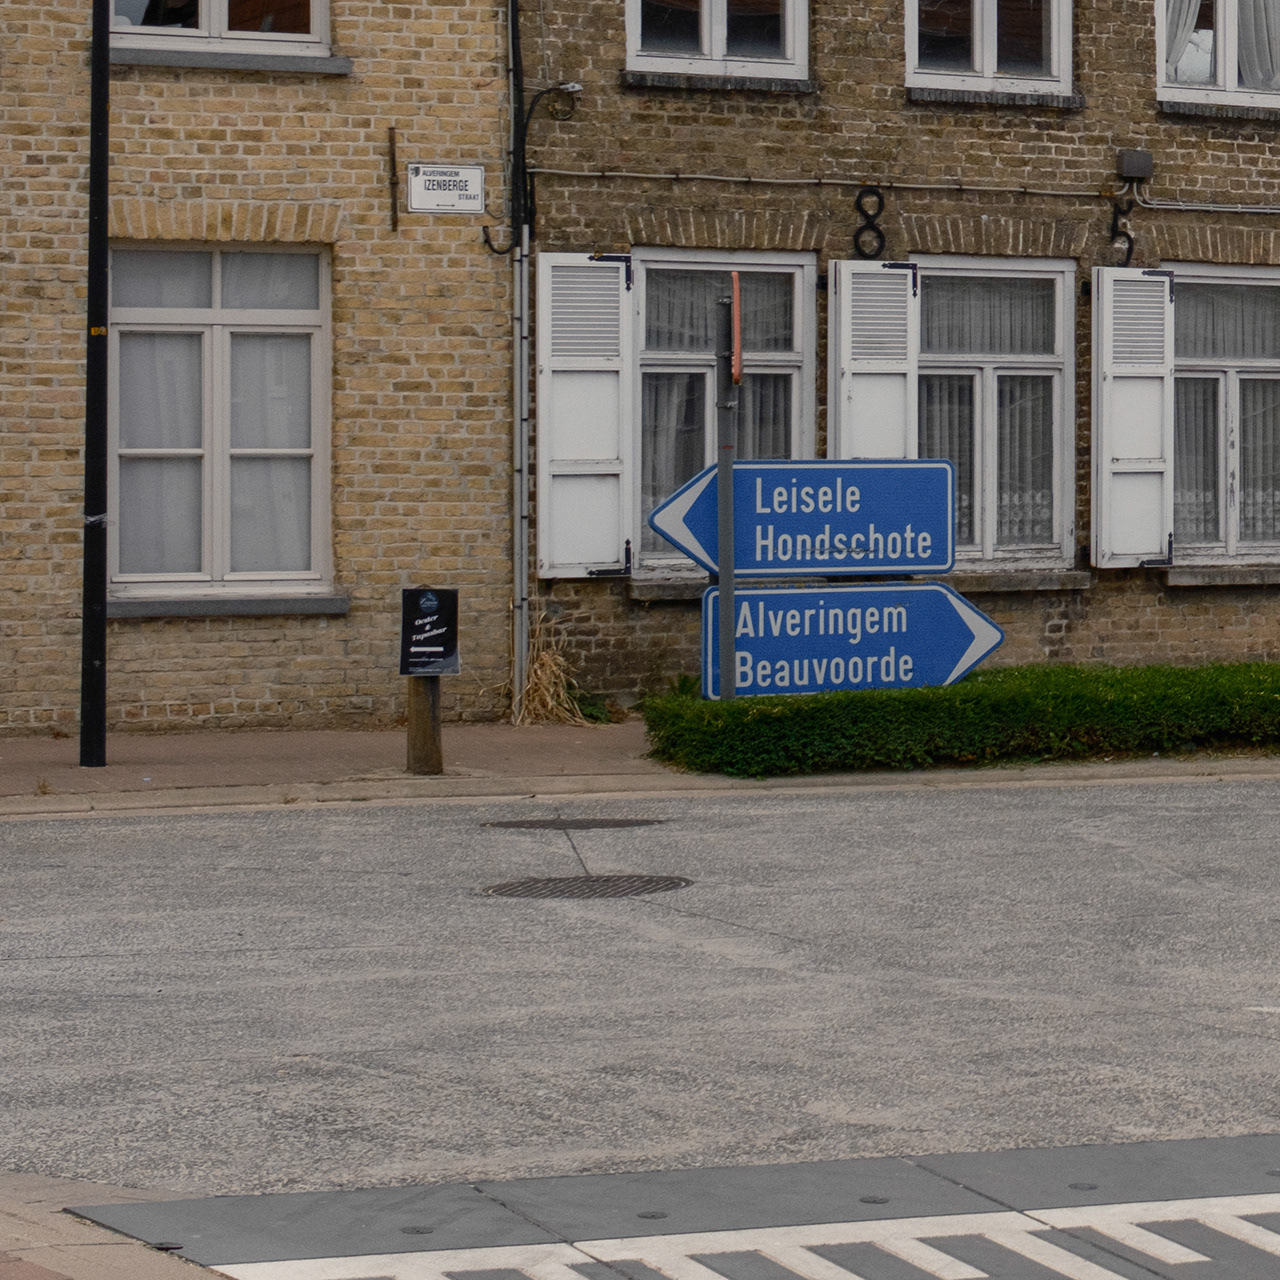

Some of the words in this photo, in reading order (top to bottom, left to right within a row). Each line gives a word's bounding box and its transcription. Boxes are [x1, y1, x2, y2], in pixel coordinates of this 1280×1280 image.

[422, 170, 460, 178] ALVERINGEM
[424, 179, 469, 191] IZENBERGE
[755, 477, 861, 513] Leisele
[755, 524, 932, 561] Hondschote
[735, 600, 907, 644] Alveringem
[735, 646, 913, 688] Beauvoorde
